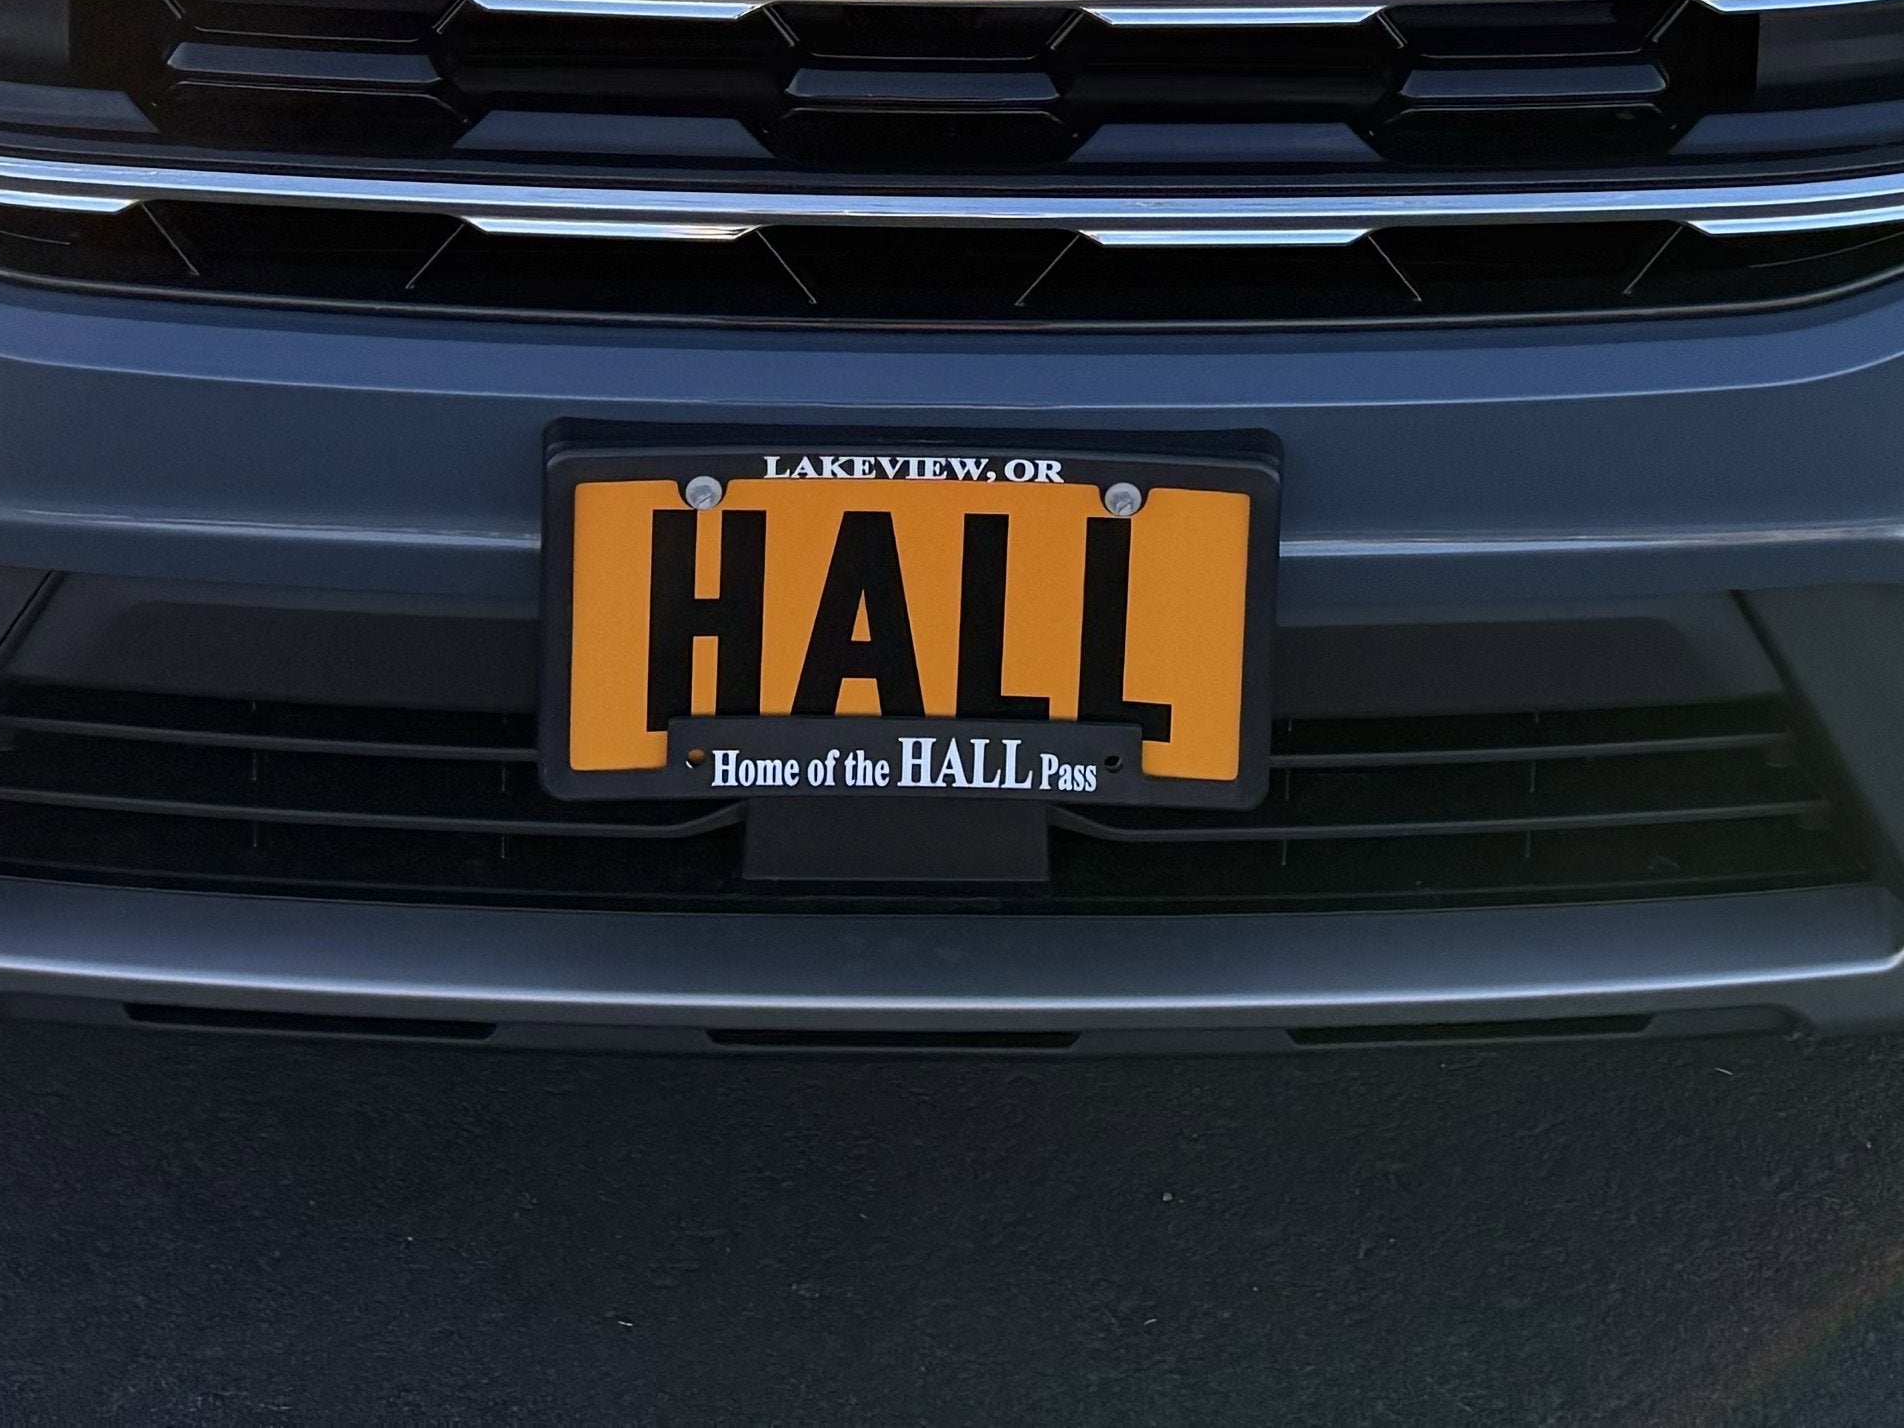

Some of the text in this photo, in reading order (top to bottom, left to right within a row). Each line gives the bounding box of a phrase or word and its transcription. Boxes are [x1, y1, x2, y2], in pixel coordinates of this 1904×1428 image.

[764, 456, 1065, 484] LAKEVIEW, OR
[646, 509, 1173, 743] HALL
[712, 737, 1097, 792] Home of the HALL Pass
